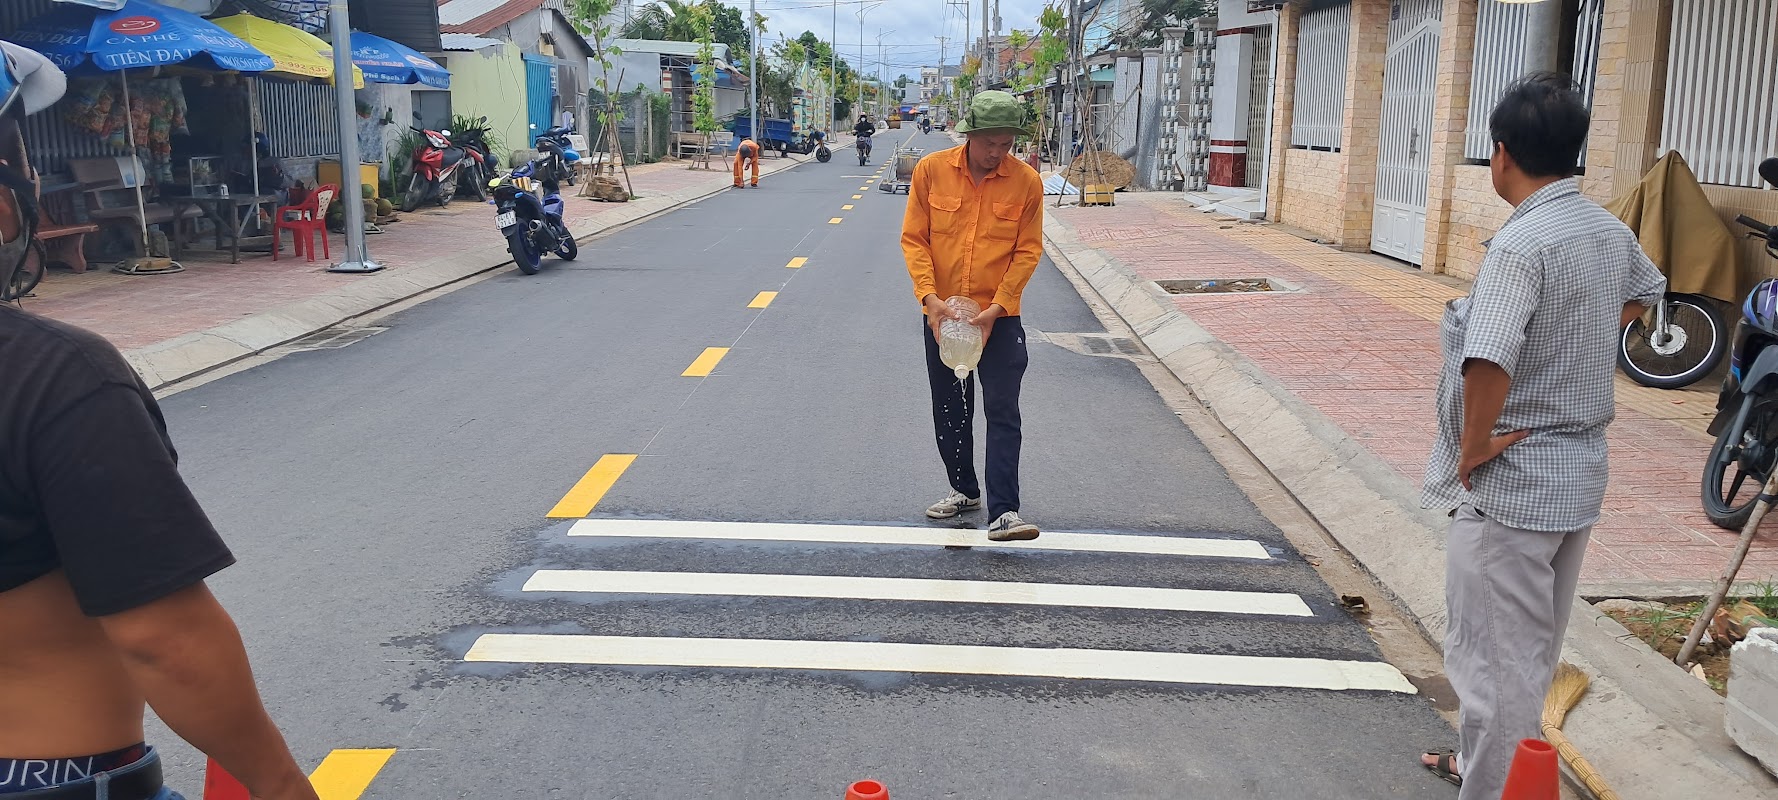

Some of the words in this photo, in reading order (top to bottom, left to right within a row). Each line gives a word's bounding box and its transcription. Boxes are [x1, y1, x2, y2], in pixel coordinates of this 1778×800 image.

[141, 32, 181, 43] PHÊ
[44, 52, 71, 66] 756
[106, 48, 152, 67] TIÊN
[155, 48, 195, 62] ĐẠT
